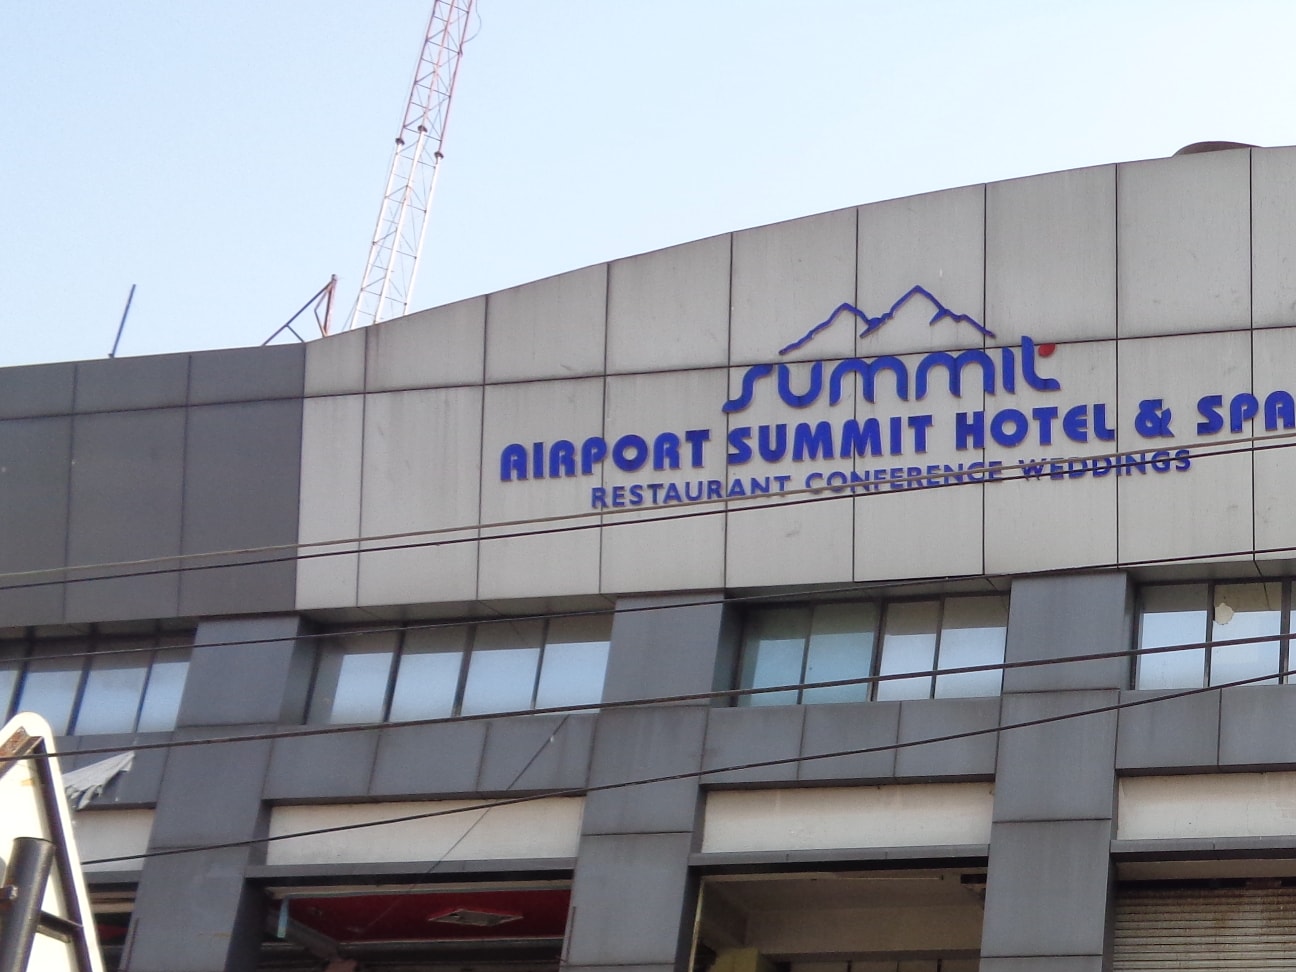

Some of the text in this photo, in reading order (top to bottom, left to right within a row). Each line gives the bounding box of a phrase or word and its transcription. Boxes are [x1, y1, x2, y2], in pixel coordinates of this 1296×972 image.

[501, 390, 1296, 482] AIRPORT SUMMIT HOTEL & SPA
[591, 449, 1191, 509] RESTAURANT CONFERENCE WEDDINGS
